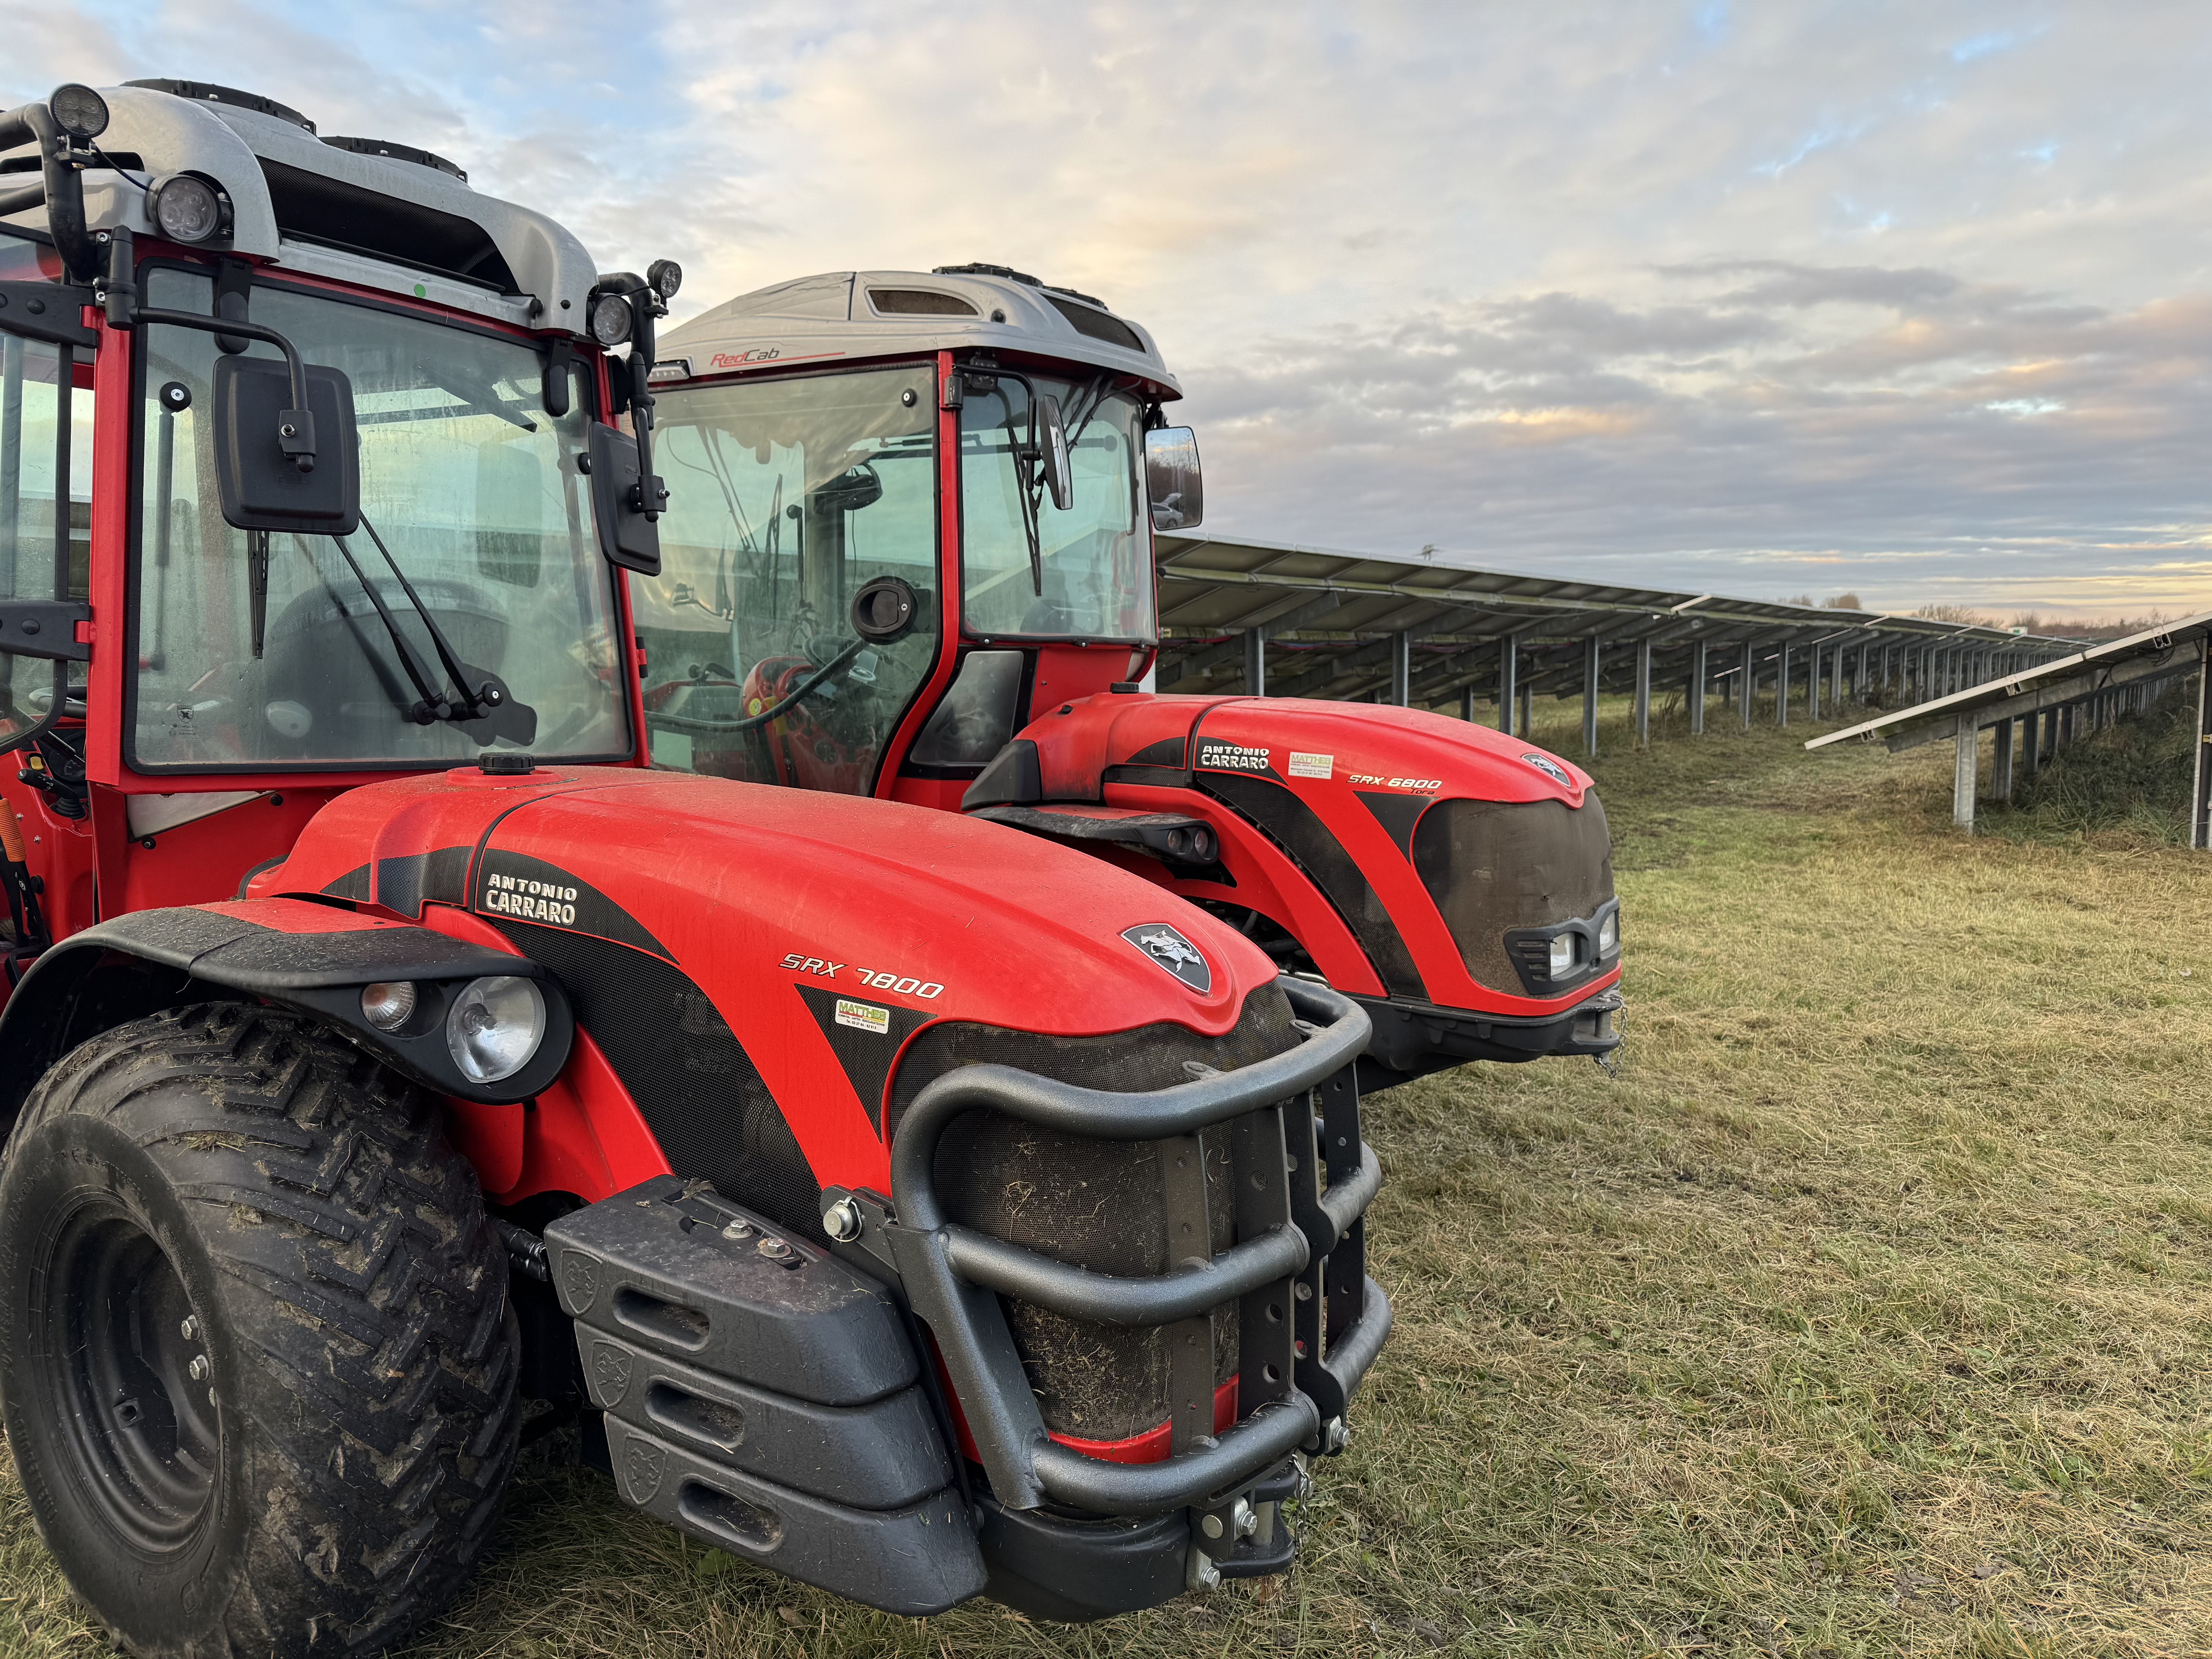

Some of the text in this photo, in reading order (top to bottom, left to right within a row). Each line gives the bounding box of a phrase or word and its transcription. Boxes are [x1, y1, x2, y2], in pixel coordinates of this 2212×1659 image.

[710, 348, 780, 367] RedCab
[1202, 745, 1270, 757] ANTONIO
[1201, 754, 1269, 769] CARRARO
[1346, 774, 1442, 789] SRX 6800
[488, 873, 578, 902] ANTONIO
[486, 889, 575, 926] CARRARO
[778, 953, 945, 999] SRX 7800
[839, 1001, 886, 1020] MATTHES
